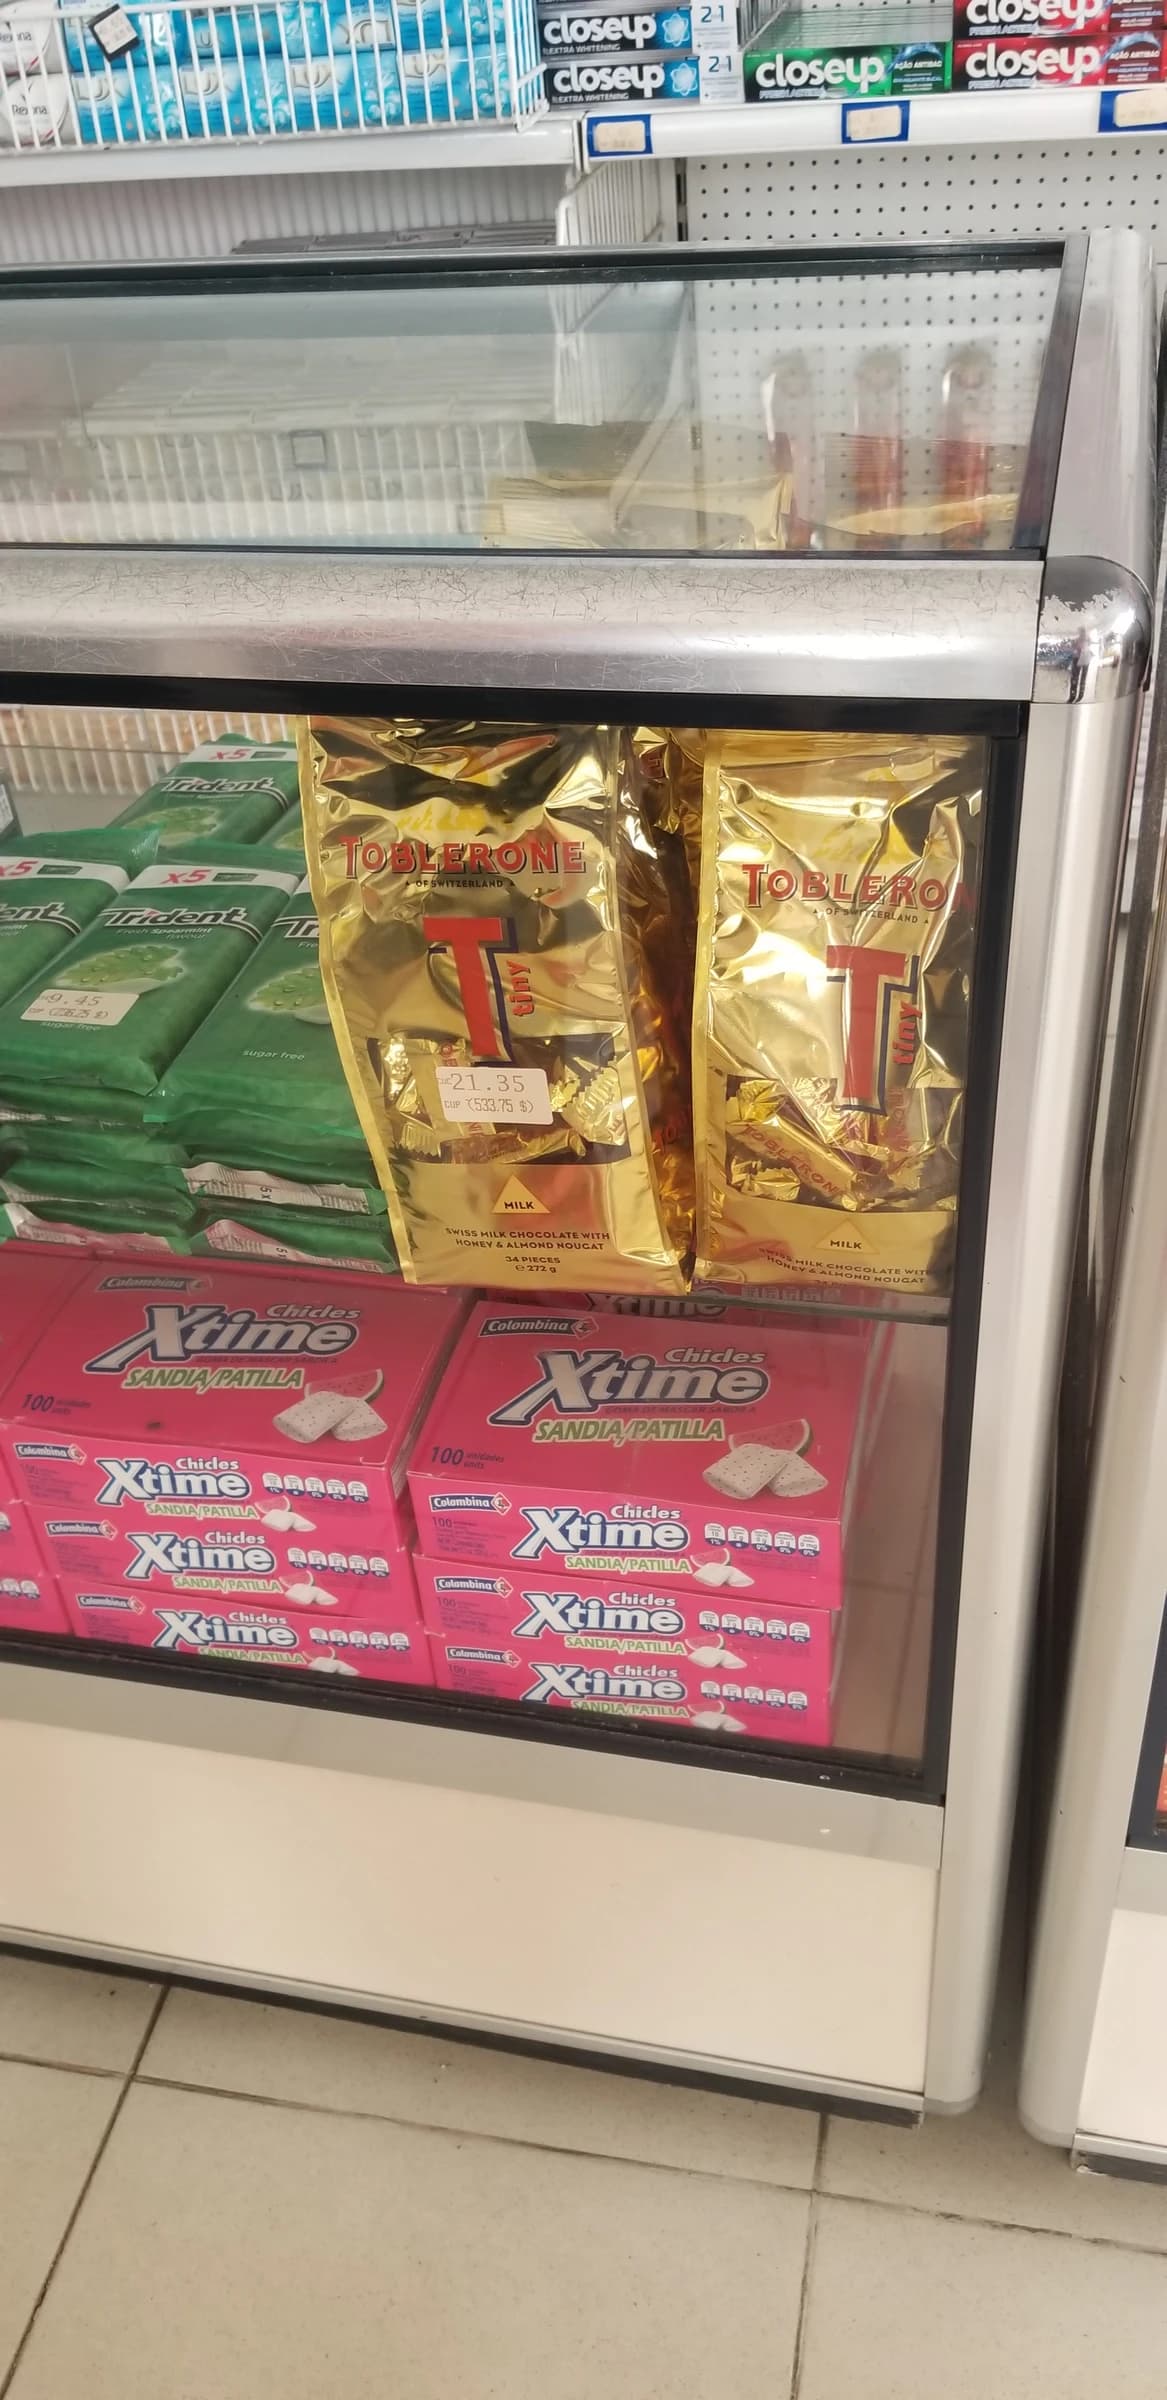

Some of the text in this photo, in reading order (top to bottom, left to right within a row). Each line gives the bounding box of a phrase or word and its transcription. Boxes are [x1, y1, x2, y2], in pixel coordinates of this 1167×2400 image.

[966, 0, 1101, 30] closeup
[543, 13, 657, 49] closeup
[755, 53, 884, 93] closeup
[965, 42, 1100, 84] closeup
[553, 63, 665, 98] closeup
[160, 776, 274, 793] Trident
[338, 835, 586, 879] TOBLERONE
[415, 879, 504, 889] OF SWITZERLAND
[0, 902, 65, 920] ent
[102, 907, 248, 927] Trident
[506, 960, 534, 1017] tiny
[892, 1003, 922, 1065] tiny
[242, 1049, 305, 1061] sugar free
[450, 1073, 526, 1093] 21.35
[504, 1201, 535, 1210] MILK
[445, 1227, 611, 1241] SWISS MILK CHOCOLATE WITH
[456, 1238, 493, 1249] HONEY
[506, 1241, 554, 1250] ALMOND
[557, 1242, 605, 1251] NOUGAT
[830, 1240, 863, 1250] MILK
[521, 1256, 561, 1264] PIECES
[526, 1264, 547, 1272] 272
[767, 1255, 806, 1273] HONEY
[817, 1269, 871, 1281] ALMOND
[874, 1276, 925, 1284] NOUGAT
[795, 1258, 823, 1267] MILK
[826, 1263, 901, 1275] CHOCOLATE
[106, 1277, 186, 1291] Colombina
[266, 1304, 361, 1320] Chicles
[485, 1318, 569, 1333] Colombina
[82, 1304, 358, 1374] Xtime
[665, 1347, 767, 1365] Chicles
[122, 1367, 305, 1394] SANDIA/PATILLA
[488, 1350, 769, 1426] Xtime
[21, 1394, 55, 1413] 100
[532, 1418, 725, 1447] SANDIA/PATILLA
[175, 1456, 239, 1471] Chicles
[431, 1445, 465, 1465] 100
[95, 1457, 252, 1506] Xtime
[146, 1501, 259, 1521] SANDIA/PATILLA
[434, 1496, 490, 1508] Colombina
[611, 1504, 681, 1520] Chicles
[205, 1532, 265, 1545] Chicles
[512, 1506, 689, 1559] Xtime
[124, 1532, 277, 1580] Xtime
[564, 1555, 691, 1575] SANDIA/PATILLA
[172, 1574, 284, 1594] SANDIA/PATILLA
[438, 1579, 493, 1591] Colombina
[608, 1592, 676, 1608] Chicles
[228, 1611, 287, 1625] Chicles
[513, 1592, 686, 1639] Xtime
[151, 1609, 298, 1649] Xtime
[449, 1648, 501, 1660] Colombina
[564, 1635, 688, 1655] SANDIA/PATILLA
[613, 1664, 678, 1679] Chicles
[521, 1663, 688, 1703] Xtime
